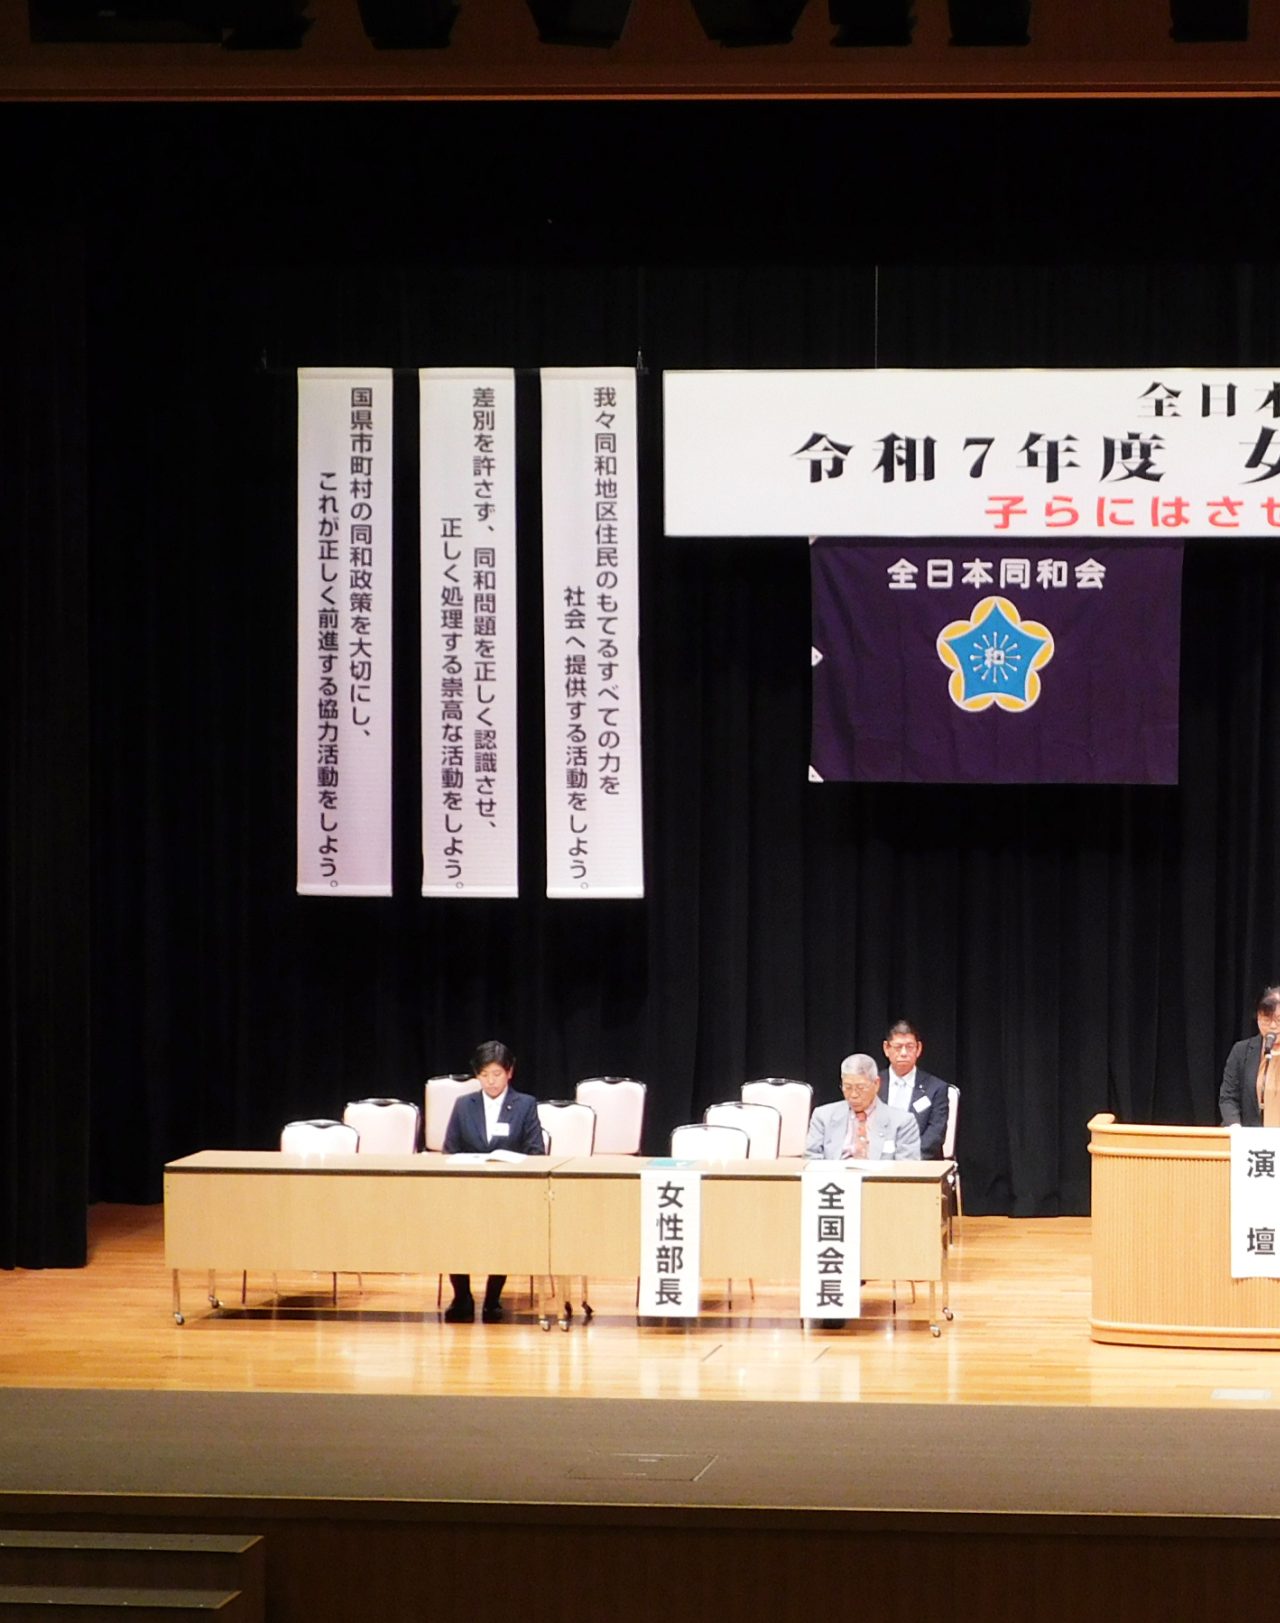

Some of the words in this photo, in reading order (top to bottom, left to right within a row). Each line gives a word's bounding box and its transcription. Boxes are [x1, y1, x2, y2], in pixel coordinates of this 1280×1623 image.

[349, 387, 373, 736] 国県市町村の同和政策を大切にし、
[473, 388, 497, 827] 差別を許さず、同和問題を正しく認識させ、
[594, 387, 620, 794] 我々同和地区住民のもてるすべての力を
[795, 432, 1164, 483] 令和7年度
[888, 559, 1105, 589] 全日本同和会
[317, 472, 339, 887] これが正しく前進する協力活動をしよう。
[441, 518, 463, 886] 正しく処理する崇高な活動をしよう。
[564, 586, 587, 889] 社会へ提供する活動をしよう。
[656, 1181, 684, 1305] 女性部長
[817, 1183, 844, 1306] 全国会長
[1247, 1150, 1275, 1254] 演壇
